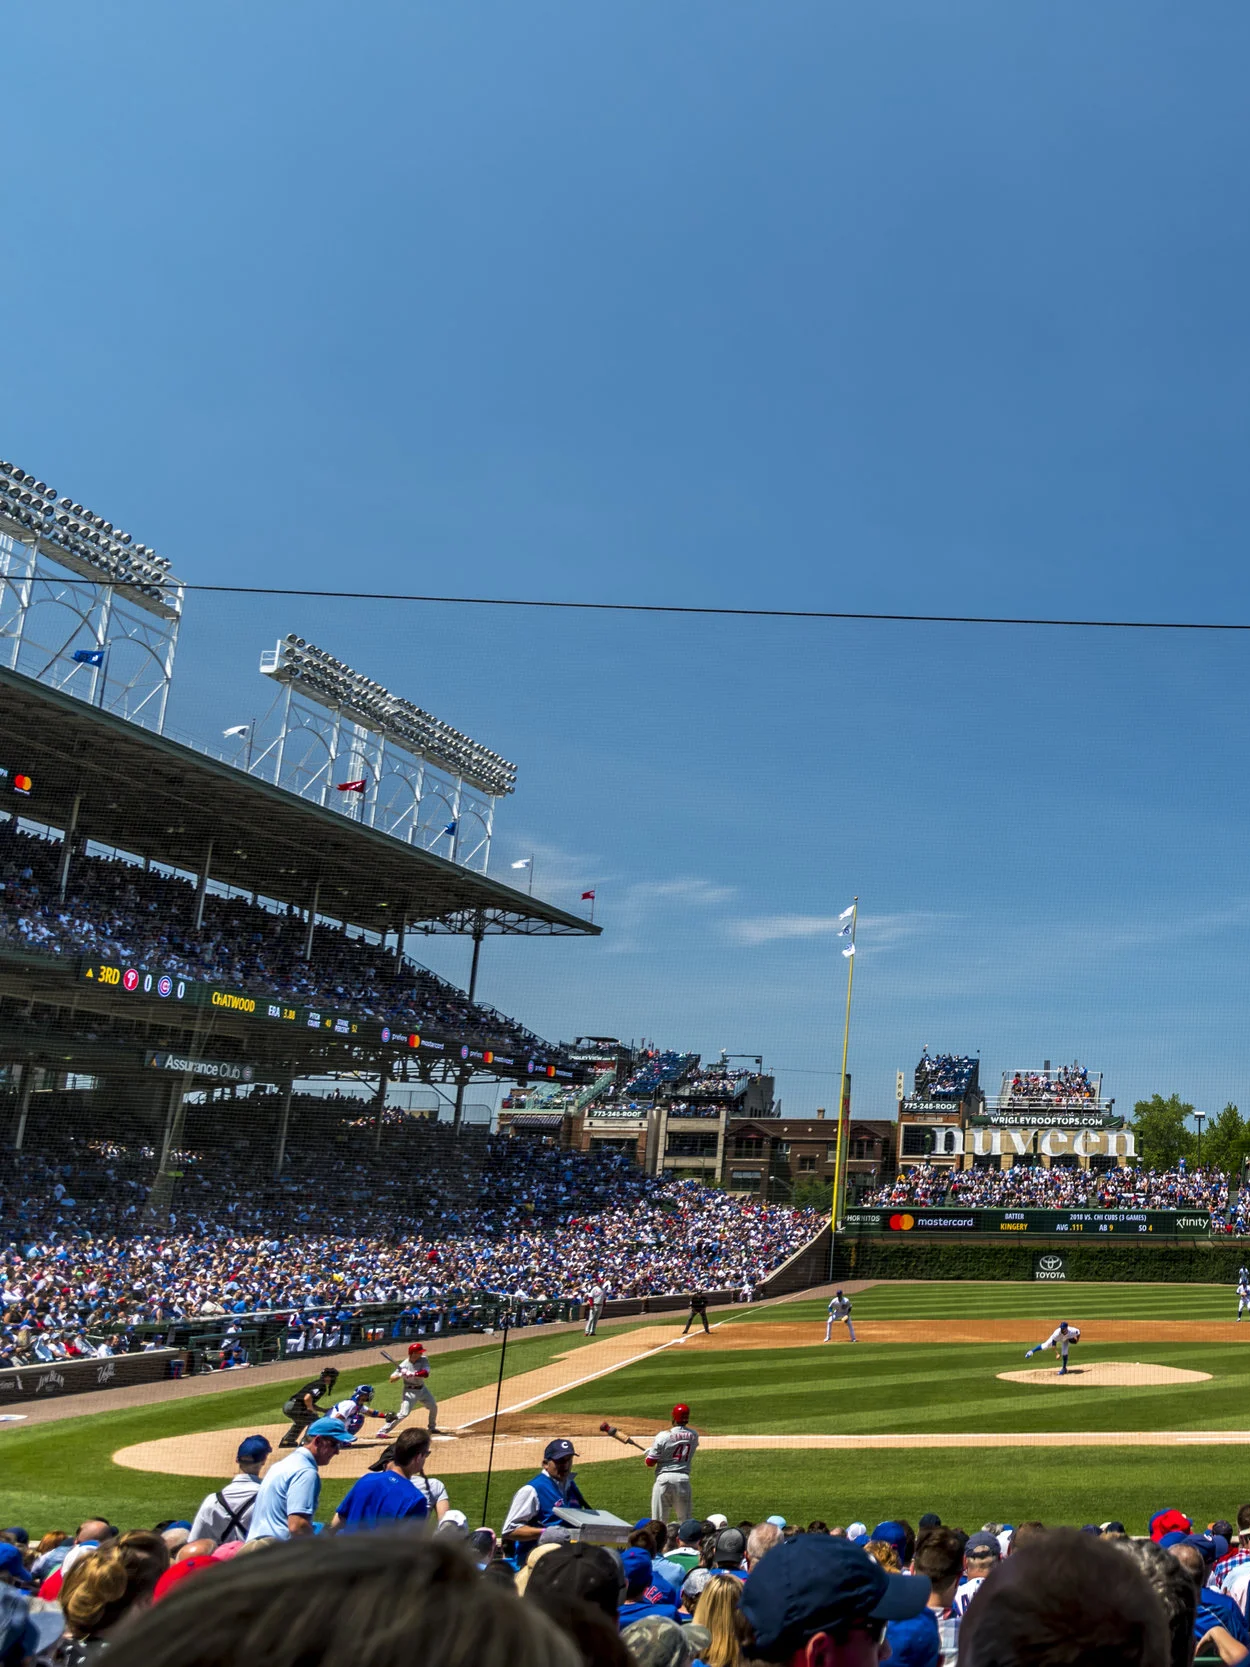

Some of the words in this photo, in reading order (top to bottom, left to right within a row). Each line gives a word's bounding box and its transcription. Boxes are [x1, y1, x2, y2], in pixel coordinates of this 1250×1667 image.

[98, 966, 121, 985] 3RD
[144, 974, 153, 992] 0
[177, 982, 185, 999] 0
[212, 991, 256, 1013] CHATWOOD
[268, 1005, 280, 1018] ERA
[165, 1054, 218, 1076] Assurance
[219, 1063, 241, 1079] Club
[991, 1116, 1103, 1126] WRIGLEYROOFTOPS.COM
[932, 1126, 1139, 1157] nuveen
[847, 1214, 880, 1222] HORNITOS
[918, 1218, 974, 1227] mastercard
[1126, 1214, 1147, 1222] GAMES)
[1176, 1217, 1209, 1229] xfinity
[1000, 1223, 1028, 1231] KINGERY
[1056, 1224, 1069, 1232] AVG
[1099, 1224, 1108, 1232] AB
[1109, 1224, 1114, 1232] 9
[672, 1444, 691, 1462] 41
